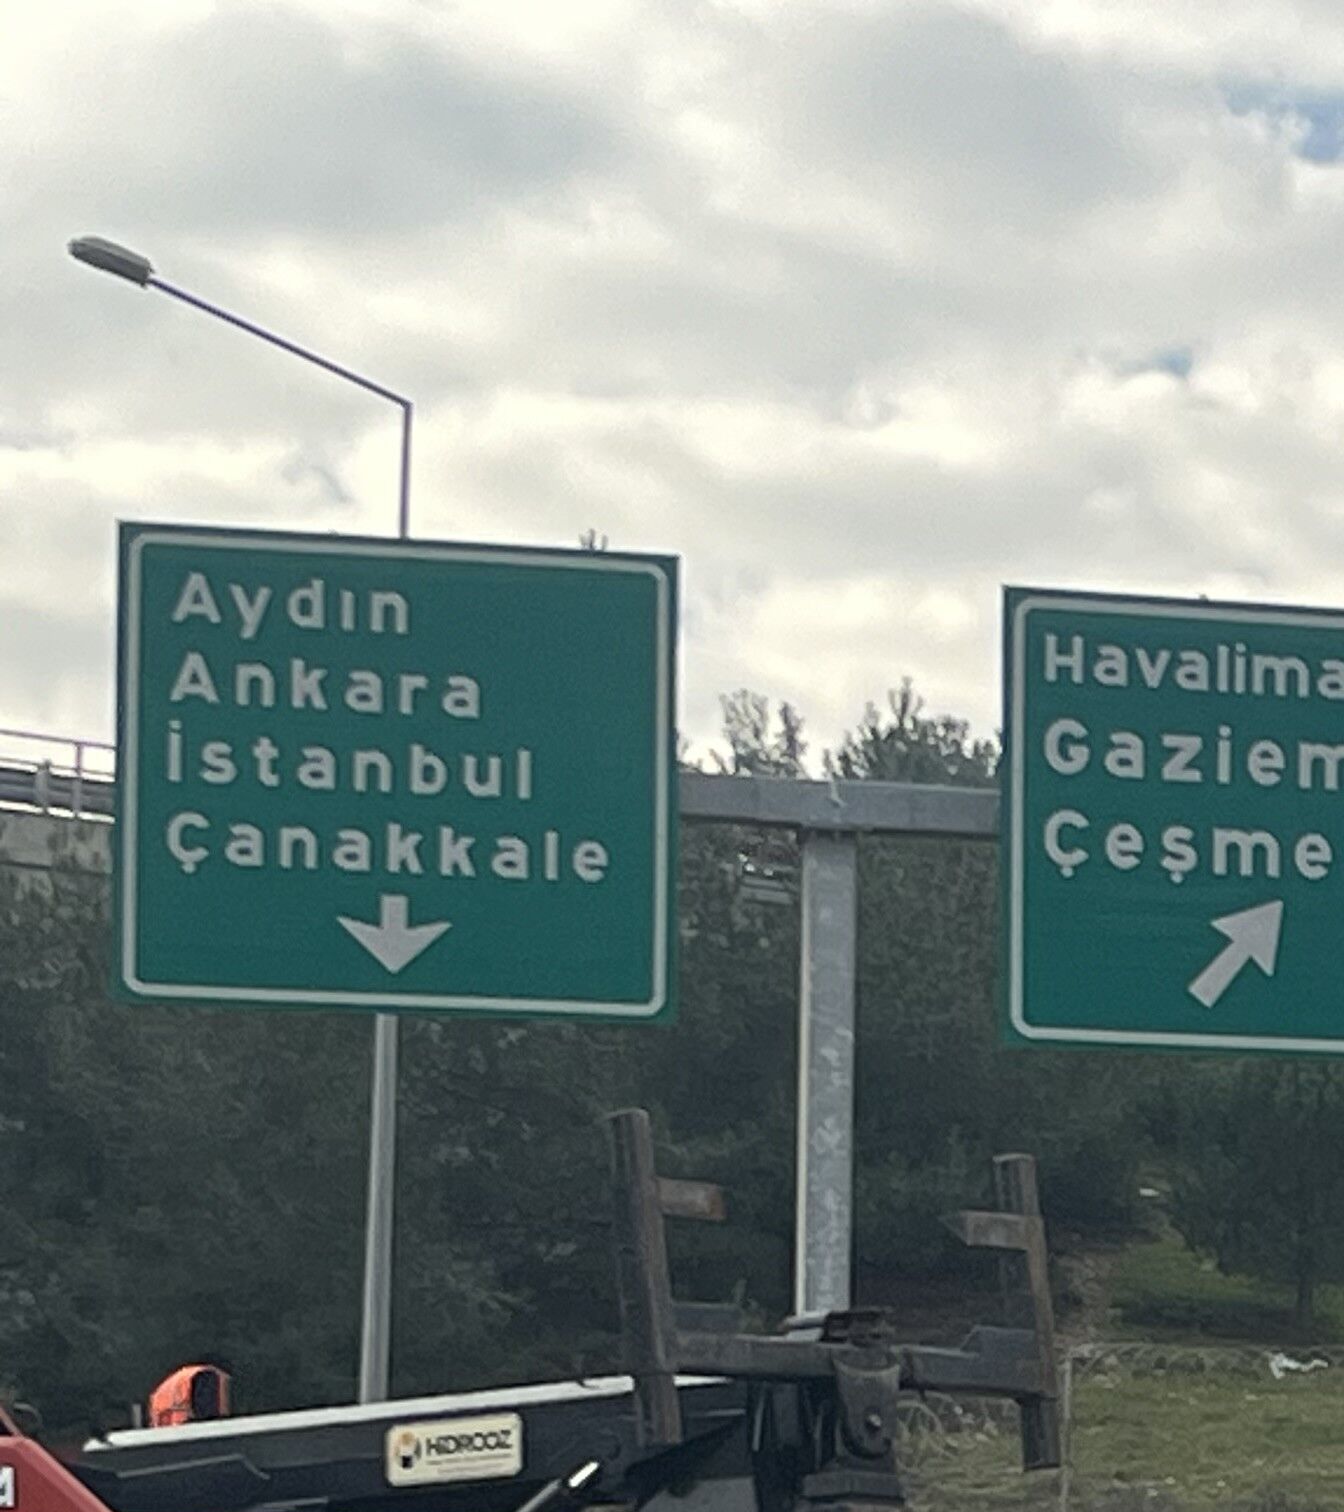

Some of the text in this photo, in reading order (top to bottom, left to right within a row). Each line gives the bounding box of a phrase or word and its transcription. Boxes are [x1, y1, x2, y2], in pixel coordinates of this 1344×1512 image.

[172, 571, 411, 640] Aydın
[169, 651, 482, 720] Ankara
[166, 720, 533, 801] İstanbul
[166, 812, 610, 884] Çanakkale
[1043, 809, 1333, 884] Çeşme
